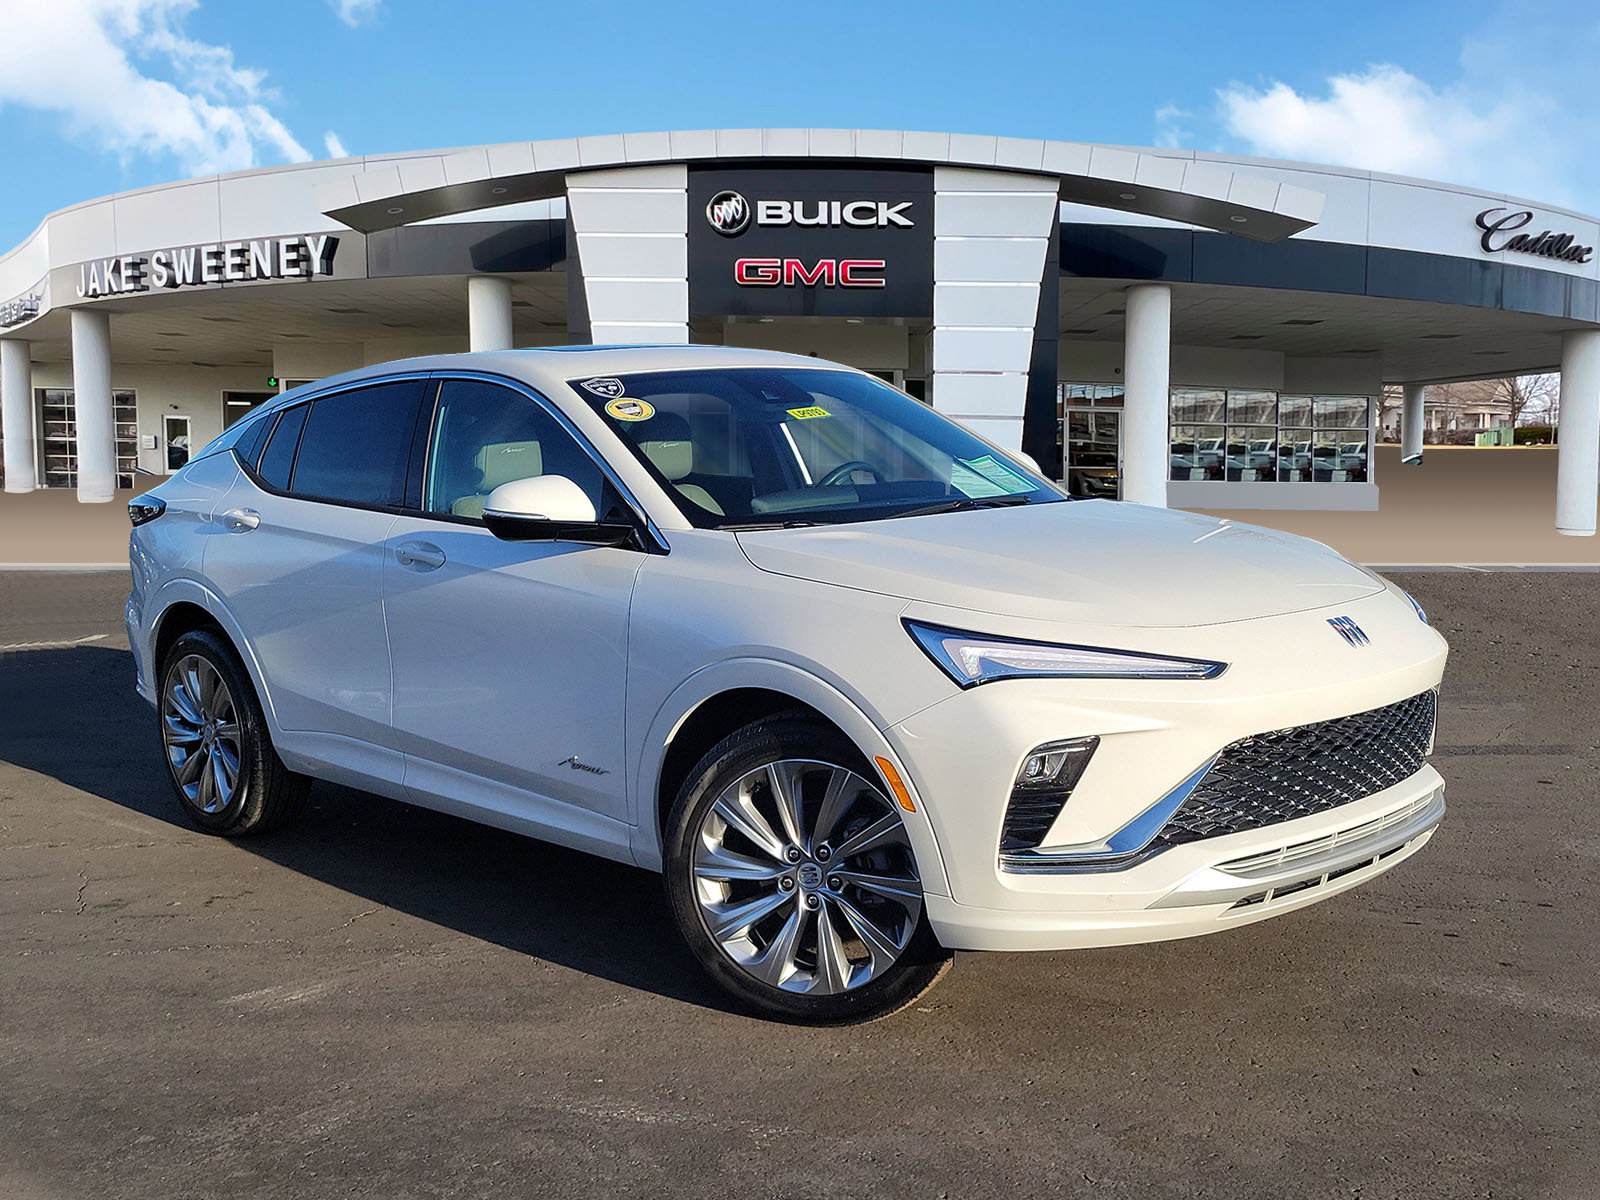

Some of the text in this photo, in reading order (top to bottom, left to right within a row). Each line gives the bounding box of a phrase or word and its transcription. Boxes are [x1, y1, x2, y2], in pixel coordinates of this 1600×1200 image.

[756, 200, 915, 227] BUICK
[1475, 207, 1593, 264] Cadillac
[76, 235, 337, 298] JAKE SWEENEY
[734, 258, 886, 286] GMC
